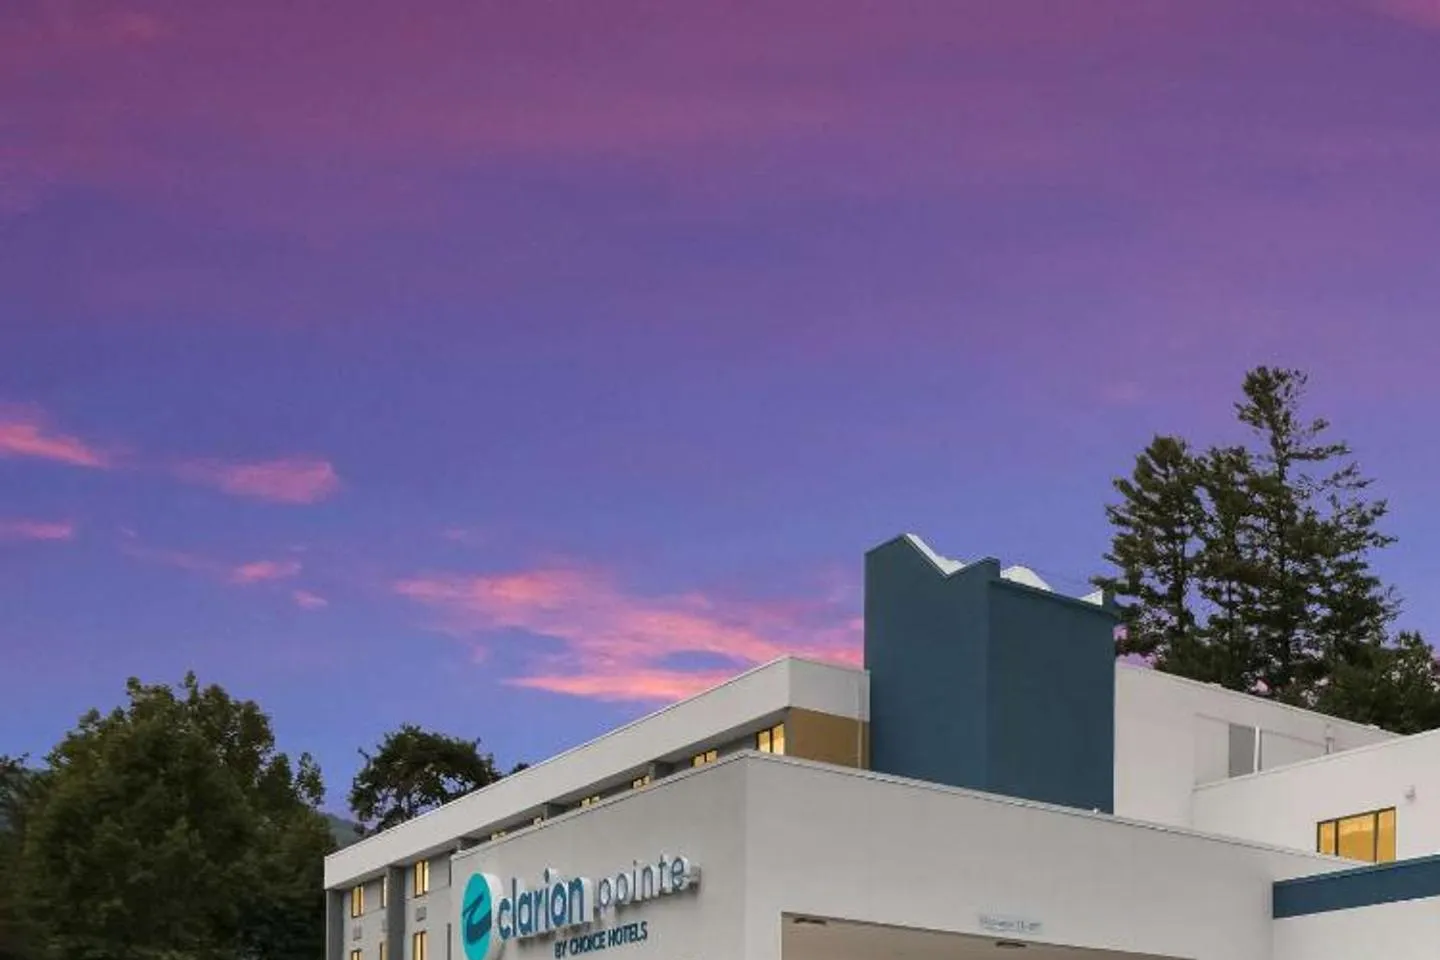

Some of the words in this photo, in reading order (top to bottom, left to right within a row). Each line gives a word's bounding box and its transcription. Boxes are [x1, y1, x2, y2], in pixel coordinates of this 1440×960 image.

[499, 867, 591, 940] clarion
[594, 854, 689, 913] pointe
[555, 940, 567, 959] BY
[569, 931, 605, 956] CHOICE
[608, 921, 648, 948] HOTELS
